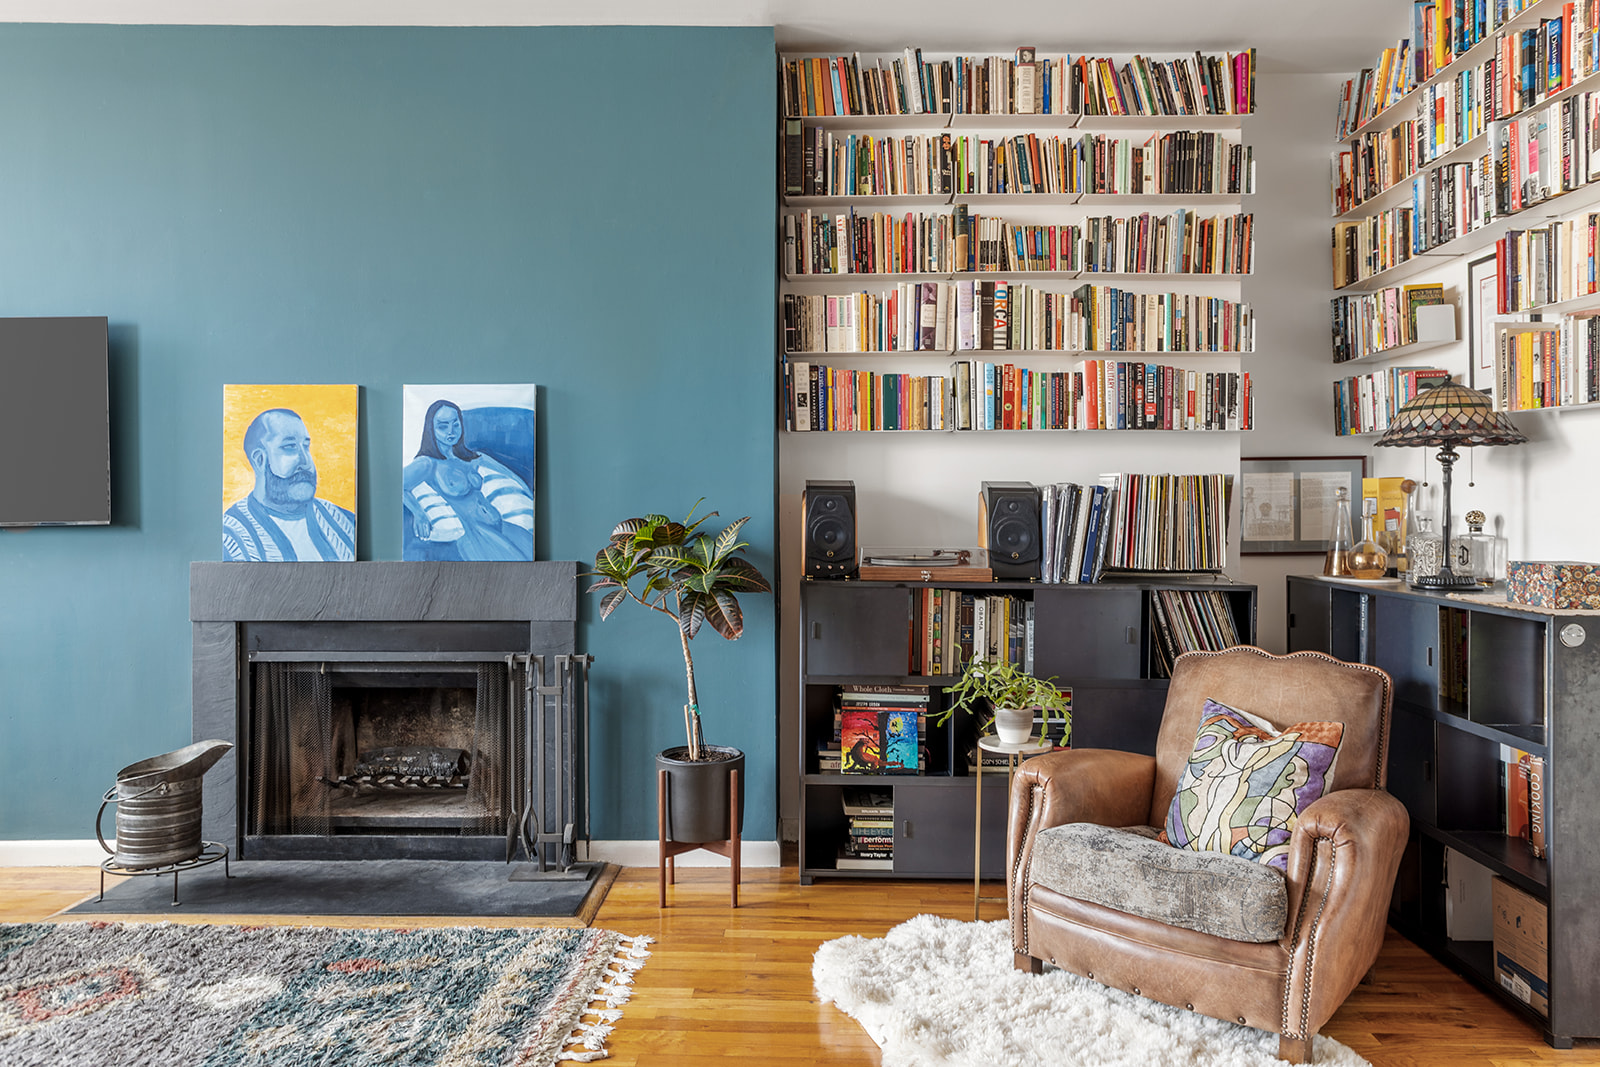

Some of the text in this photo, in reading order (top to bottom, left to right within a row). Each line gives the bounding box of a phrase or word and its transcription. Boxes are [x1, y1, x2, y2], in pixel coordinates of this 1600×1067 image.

[1550, 34, 1558, 79] Dictionary
[994, 280, 1008, 329] LORCA
[1106, 361, 1115, 390] SOLITARY
[852, 685, 873, 693] Whole
[874, 685, 892, 693] Cloth
[1530, 772, 1542, 834] COOKING
